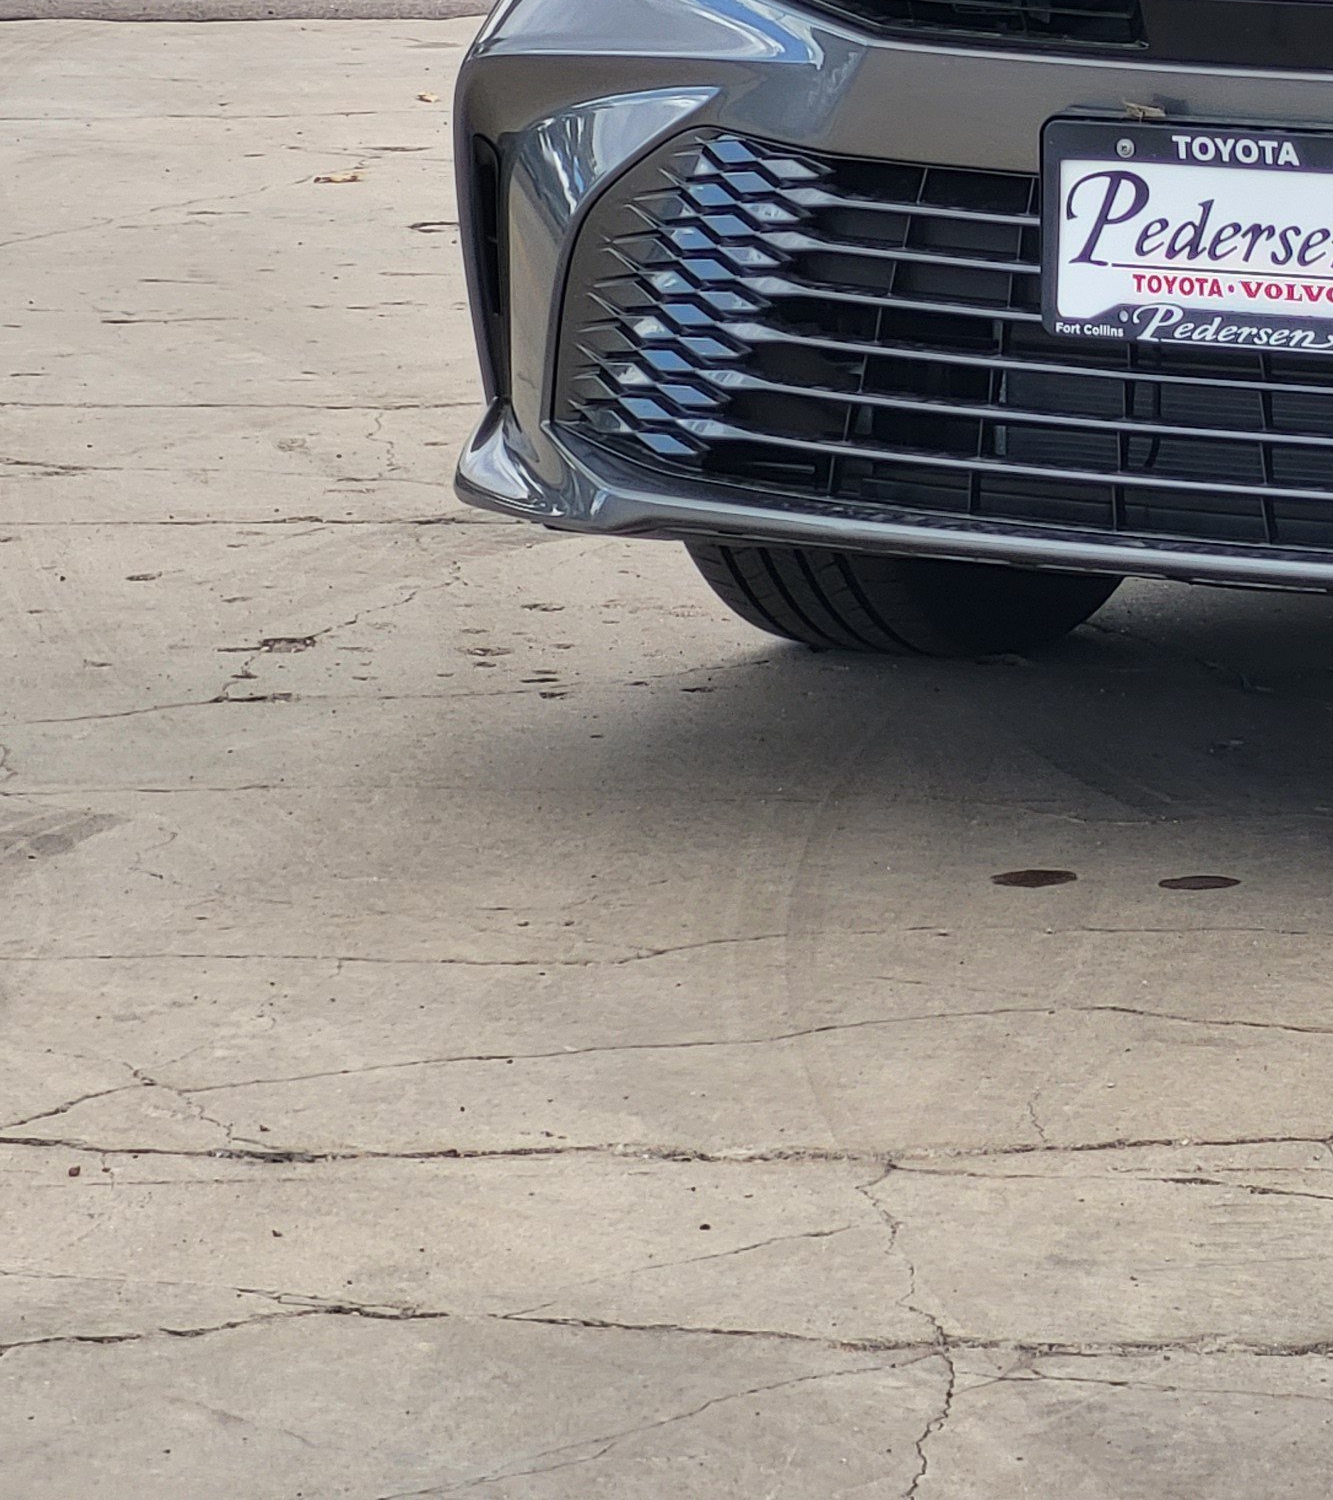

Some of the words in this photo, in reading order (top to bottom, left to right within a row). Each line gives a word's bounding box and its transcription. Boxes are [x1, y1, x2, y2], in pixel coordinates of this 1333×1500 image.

[1171, 135, 1300, 167] TOYOTA
[1132, 273, 1224, 298] TOYOTA
[1055, 321, 1081, 336] Fort
[1084, 323, 1125, 338] Collins
